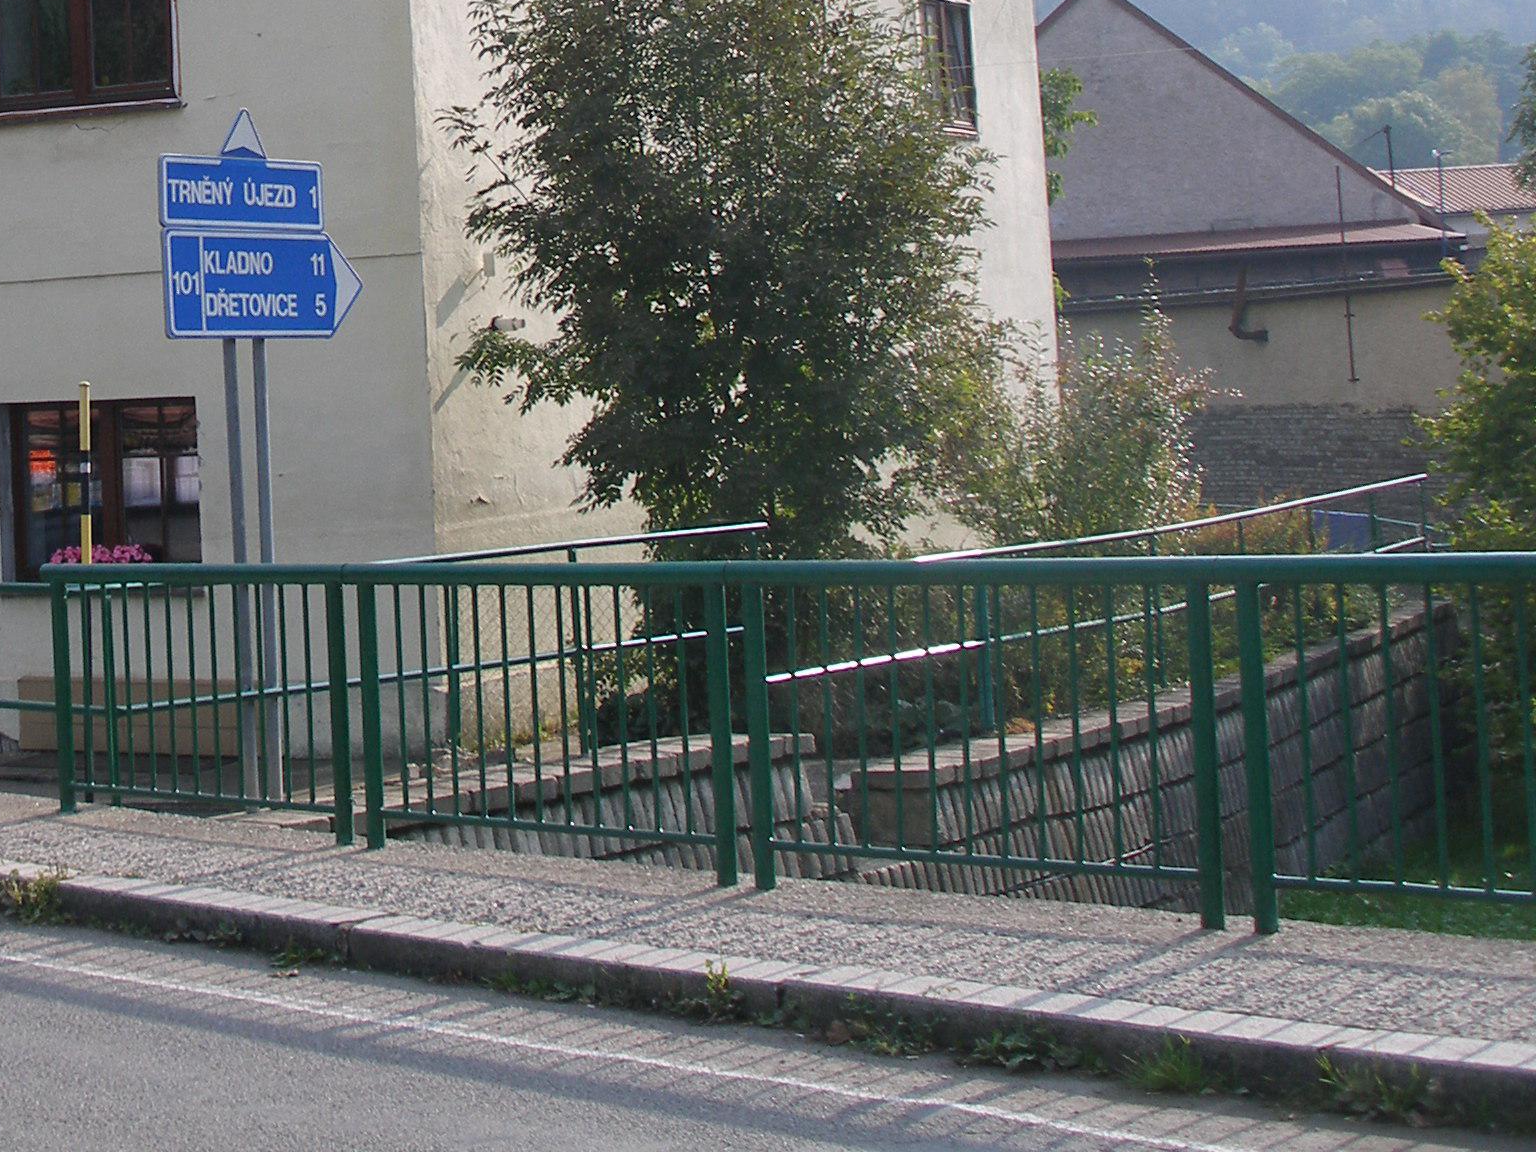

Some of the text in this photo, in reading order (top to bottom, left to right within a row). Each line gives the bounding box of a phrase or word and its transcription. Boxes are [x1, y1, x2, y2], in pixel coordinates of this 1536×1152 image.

[168, 175, 318, 209] TRNĚNÝ ÚJEZD 1
[204, 250, 326, 276] KLADNO 11
[173, 271, 200, 296] 101
[206, 288, 328, 318] DŘETOVICE 5
